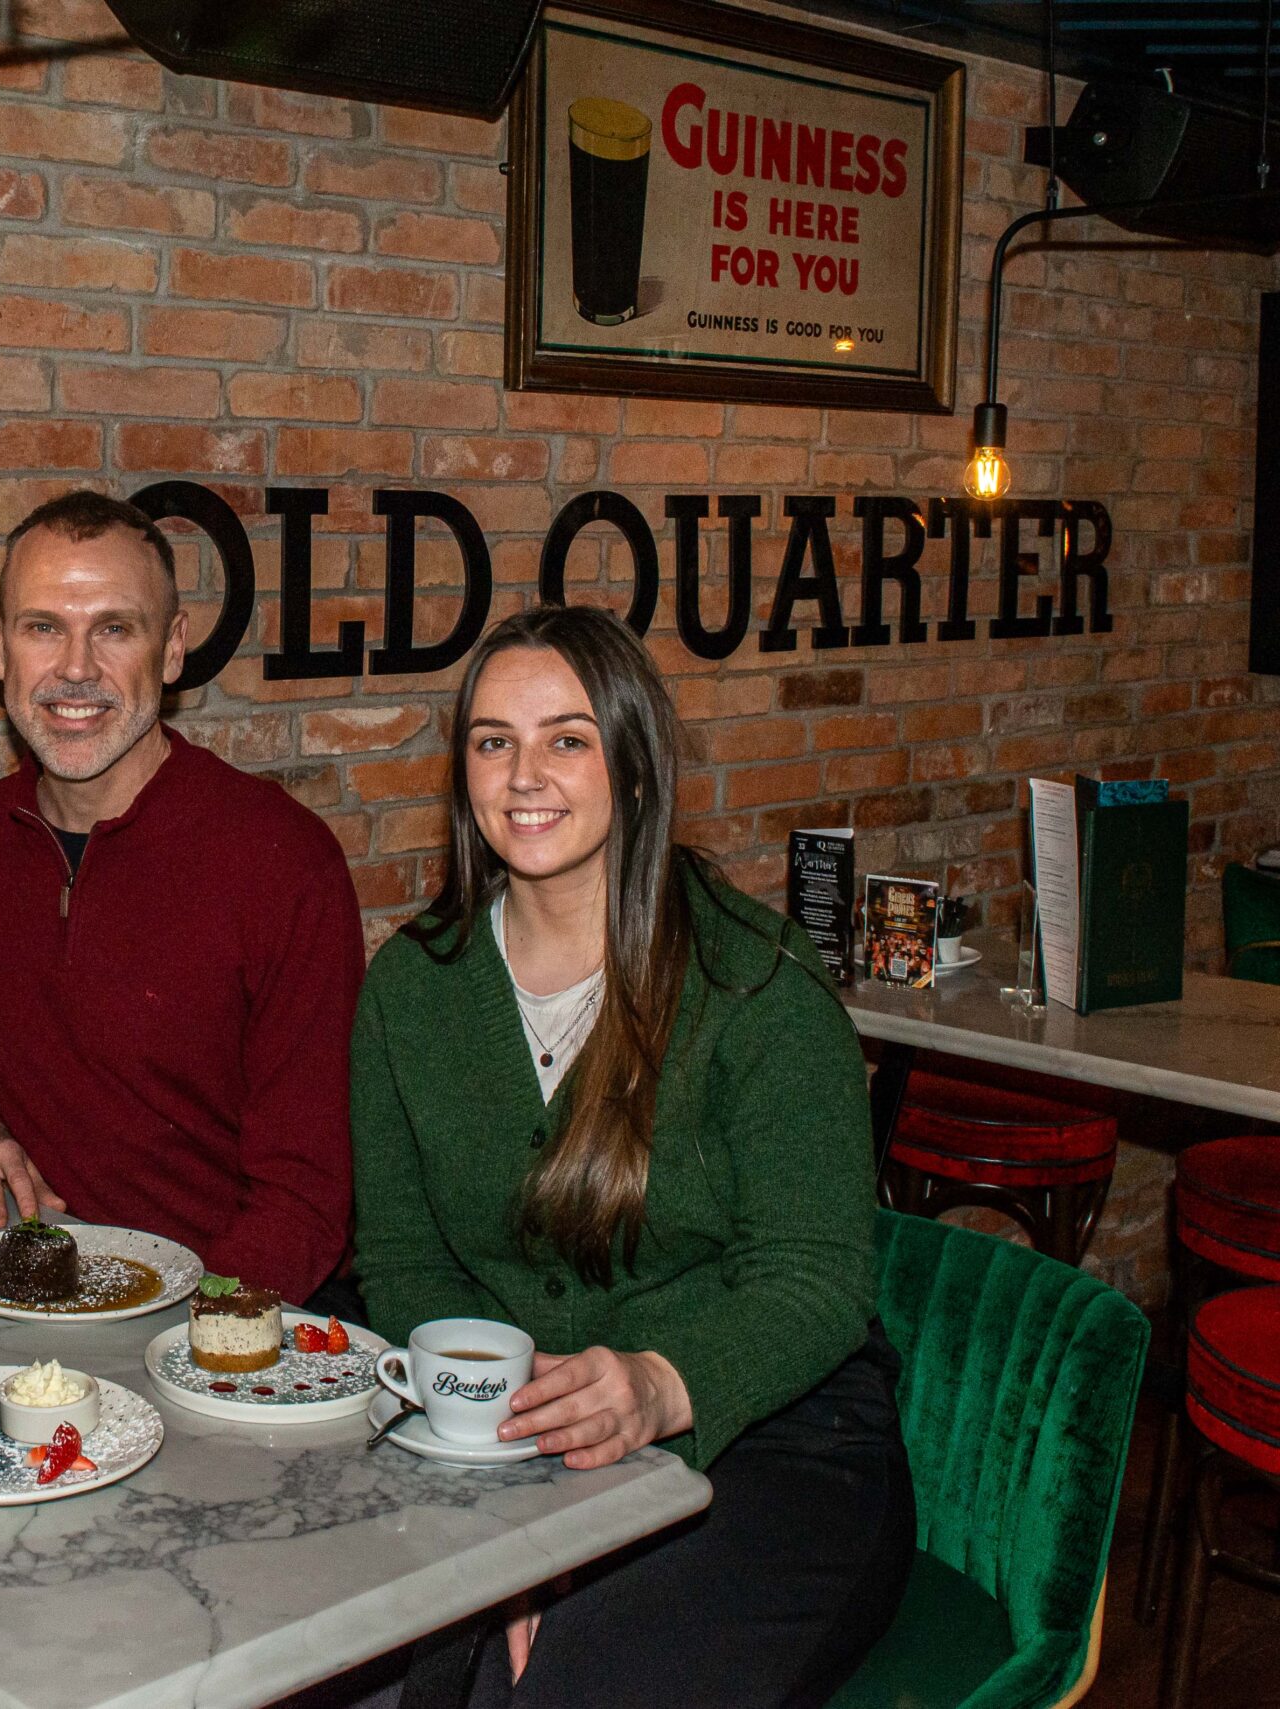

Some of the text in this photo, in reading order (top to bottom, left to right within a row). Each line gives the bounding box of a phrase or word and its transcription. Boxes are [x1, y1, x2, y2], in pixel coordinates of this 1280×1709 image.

[662, 83, 908, 198] GUINNESS
[713, 190, 859, 244] IS HERE
[711, 243, 859, 295] FOR YOU
[687, 310, 884, 343] GUINNESS IS GOOD FOR YOU
[127, 481, 1113, 691] OLD QUARTER
[433, 1372, 508, 1401] Bewley's
